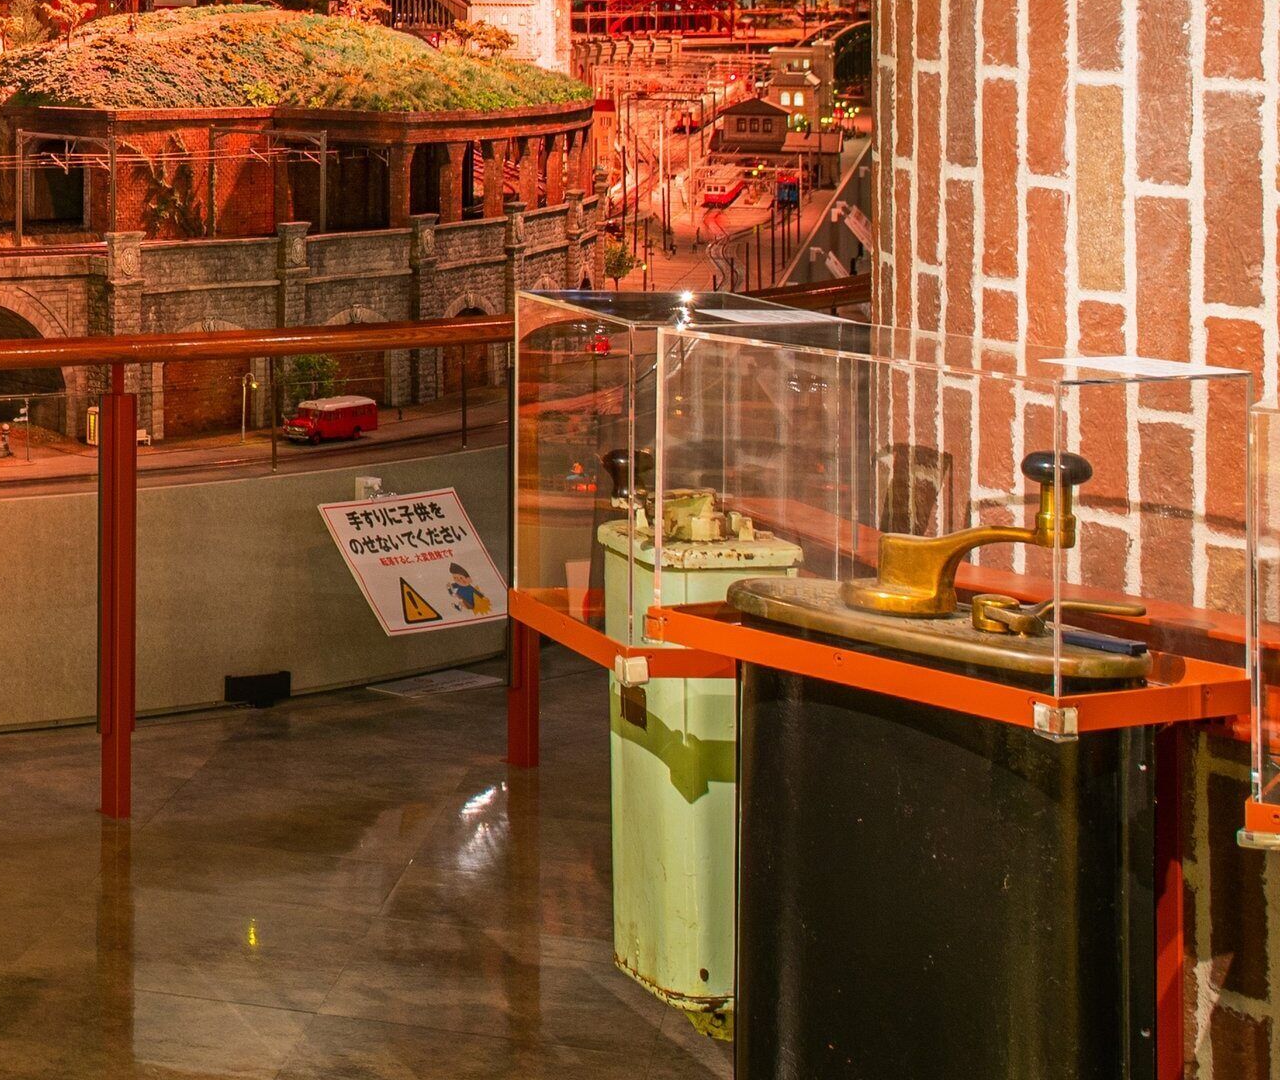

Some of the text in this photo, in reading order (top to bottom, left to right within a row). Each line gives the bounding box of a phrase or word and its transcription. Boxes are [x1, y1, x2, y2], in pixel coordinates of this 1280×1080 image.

[345, 502, 445, 531] 手すりに子供を
[349, 525, 467, 555] のせないでください
